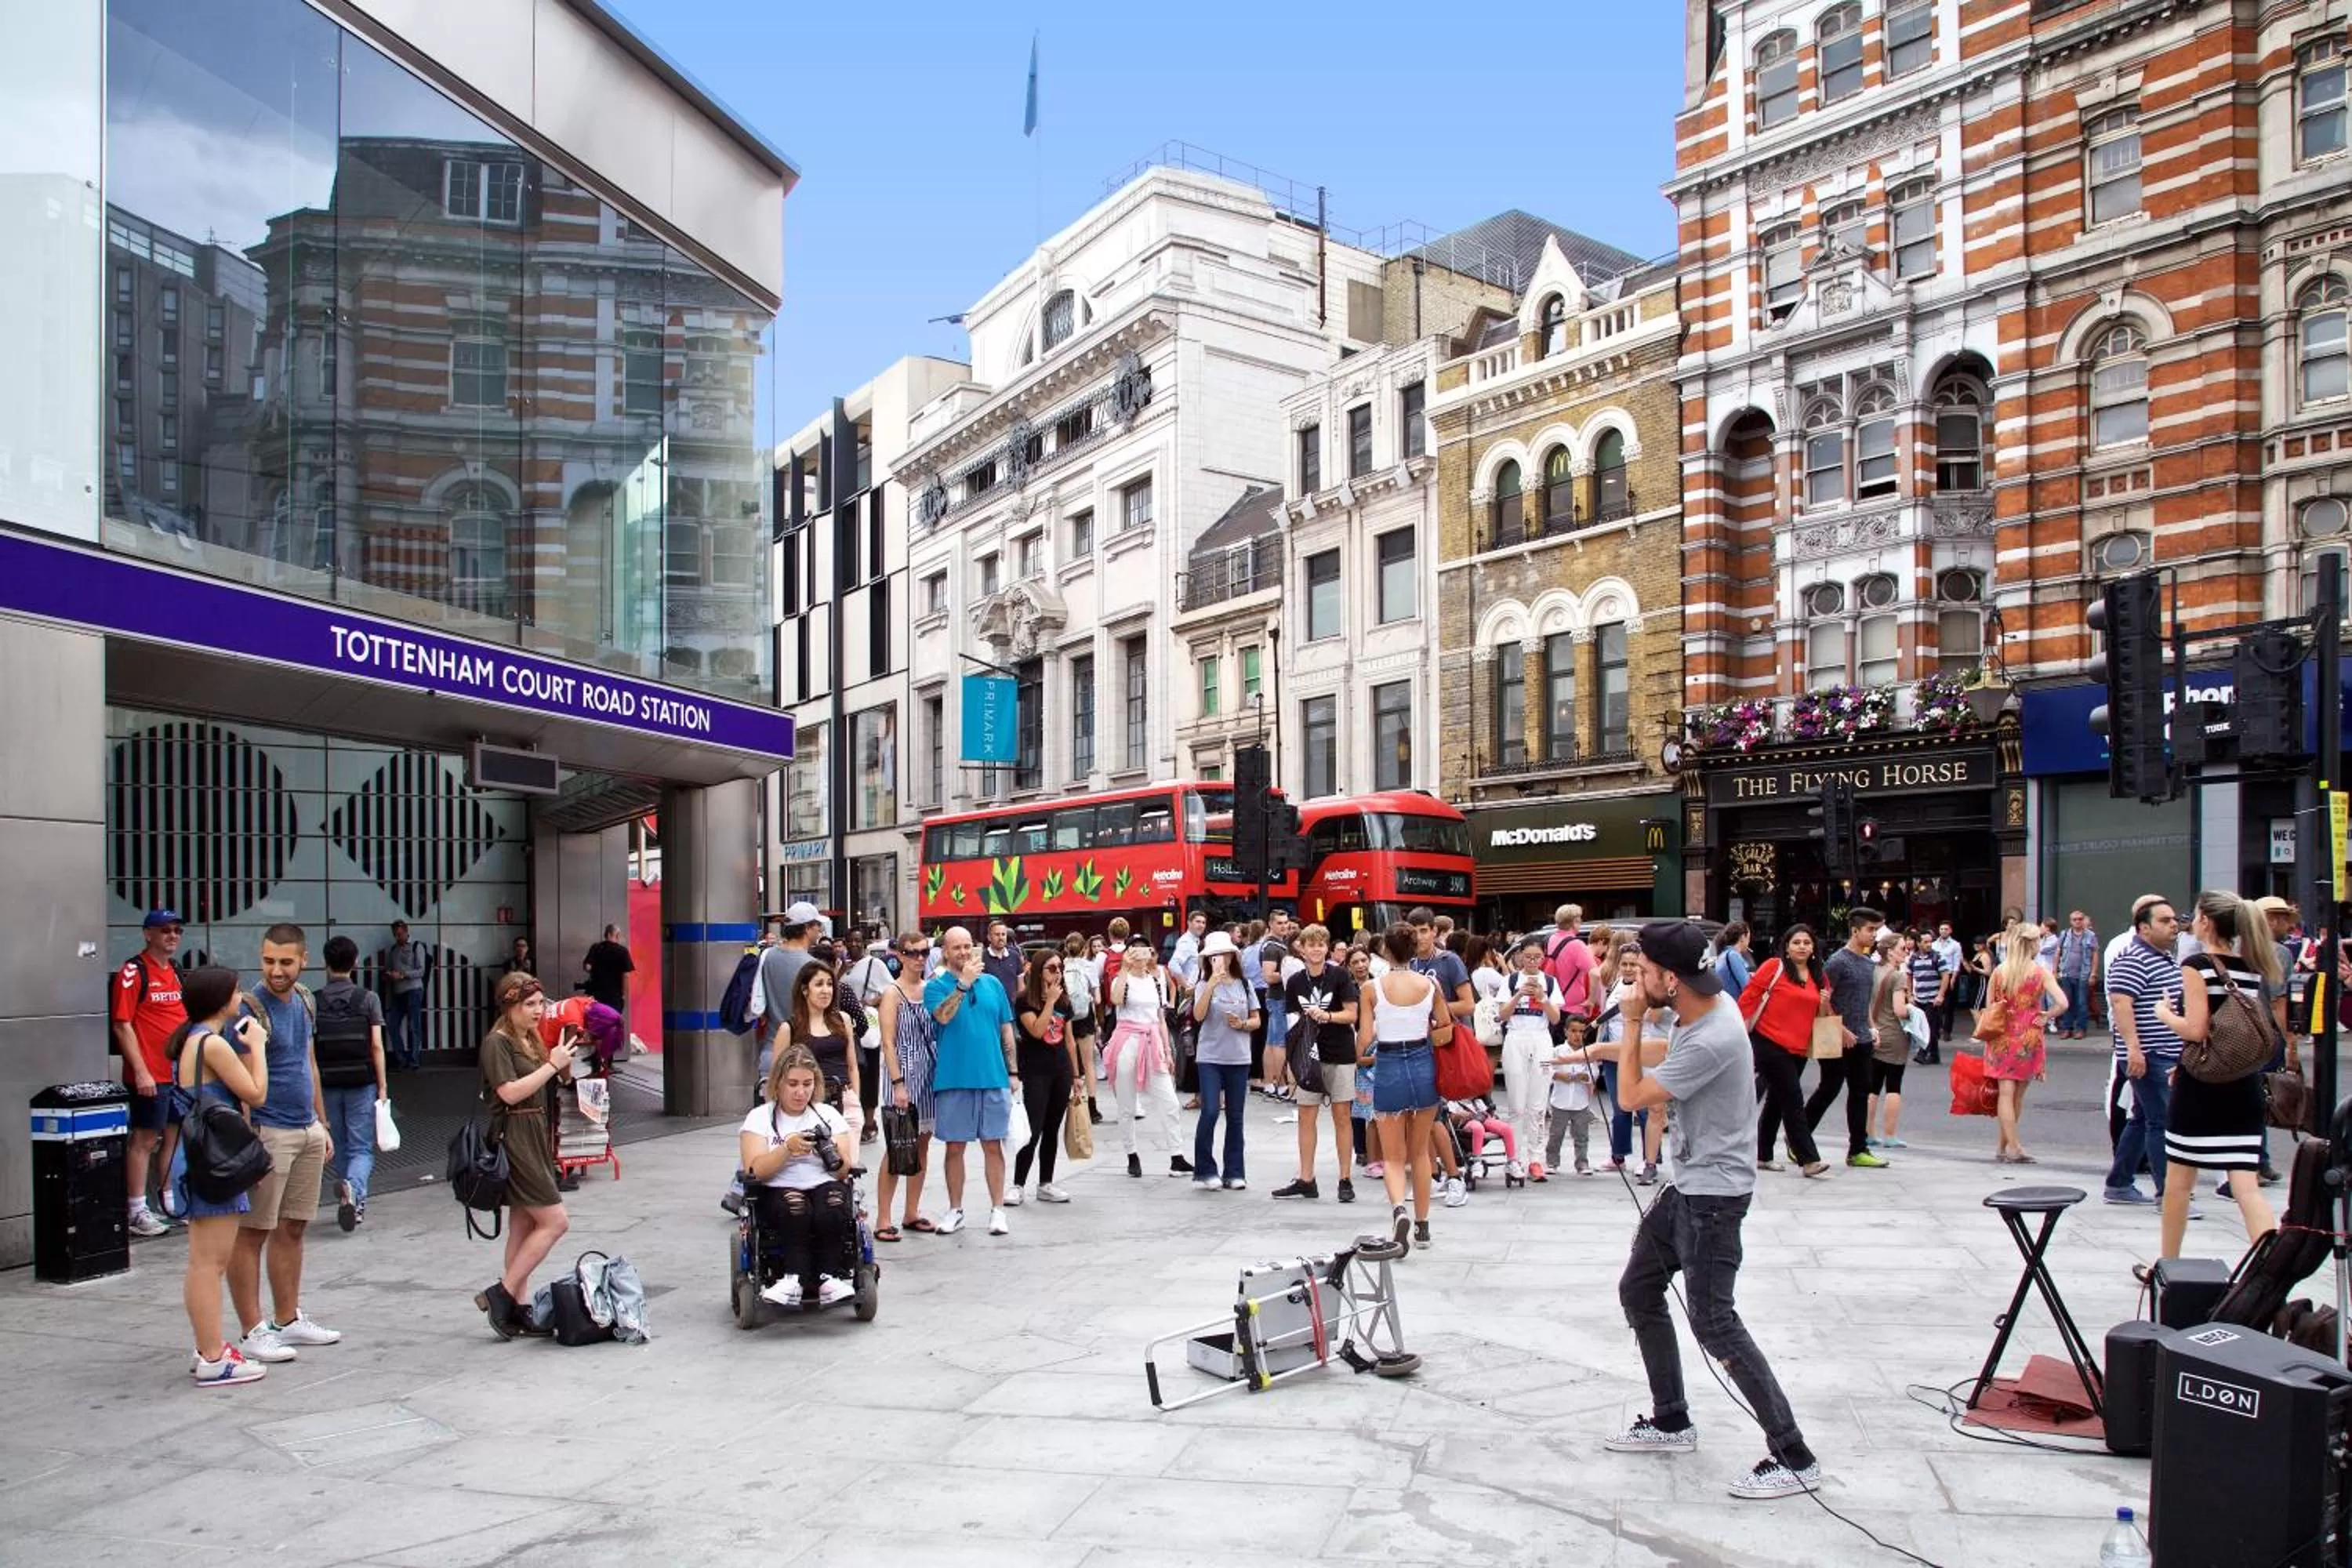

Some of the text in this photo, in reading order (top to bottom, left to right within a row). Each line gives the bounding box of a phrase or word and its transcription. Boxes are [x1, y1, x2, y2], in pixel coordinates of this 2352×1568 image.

[330, 626, 710, 731] TOTTENHAM COURT ROAD STATION
[984, 681, 996, 753] PRIMARK
[1733, 761, 1967, 797] THE FLYNG HORSE
[1491, 823, 1596, 847] McDonald's
